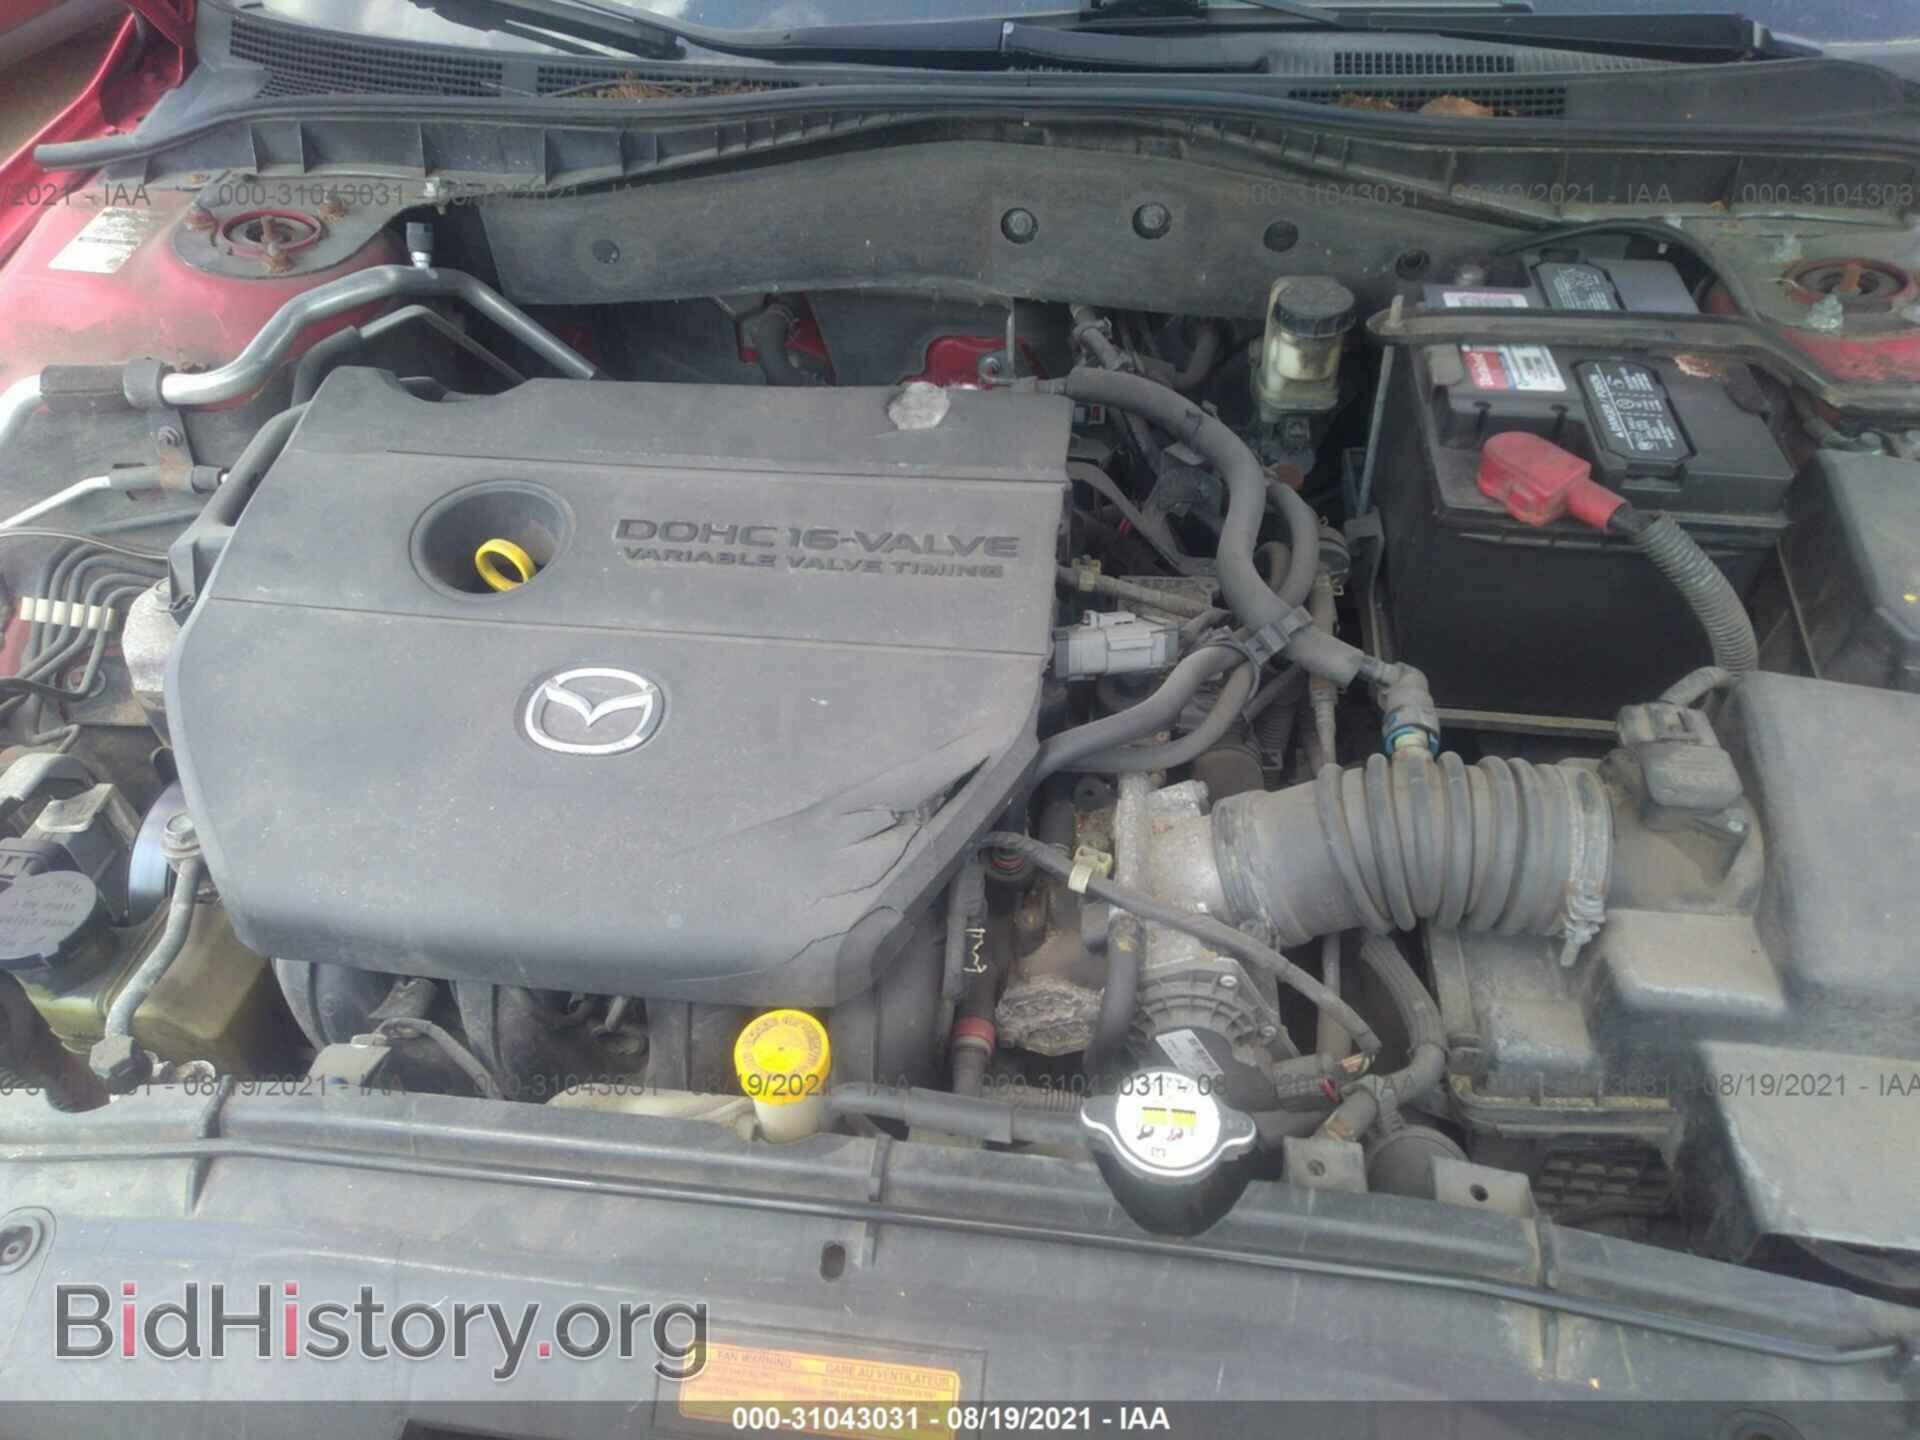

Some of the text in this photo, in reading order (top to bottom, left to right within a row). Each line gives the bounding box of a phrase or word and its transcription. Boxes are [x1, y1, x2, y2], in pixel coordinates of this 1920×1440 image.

[614, 519, 1021, 558] DOHC 16-VALVE
[623, 547, 1004, 579] VARIABLE VALVE TIMING
